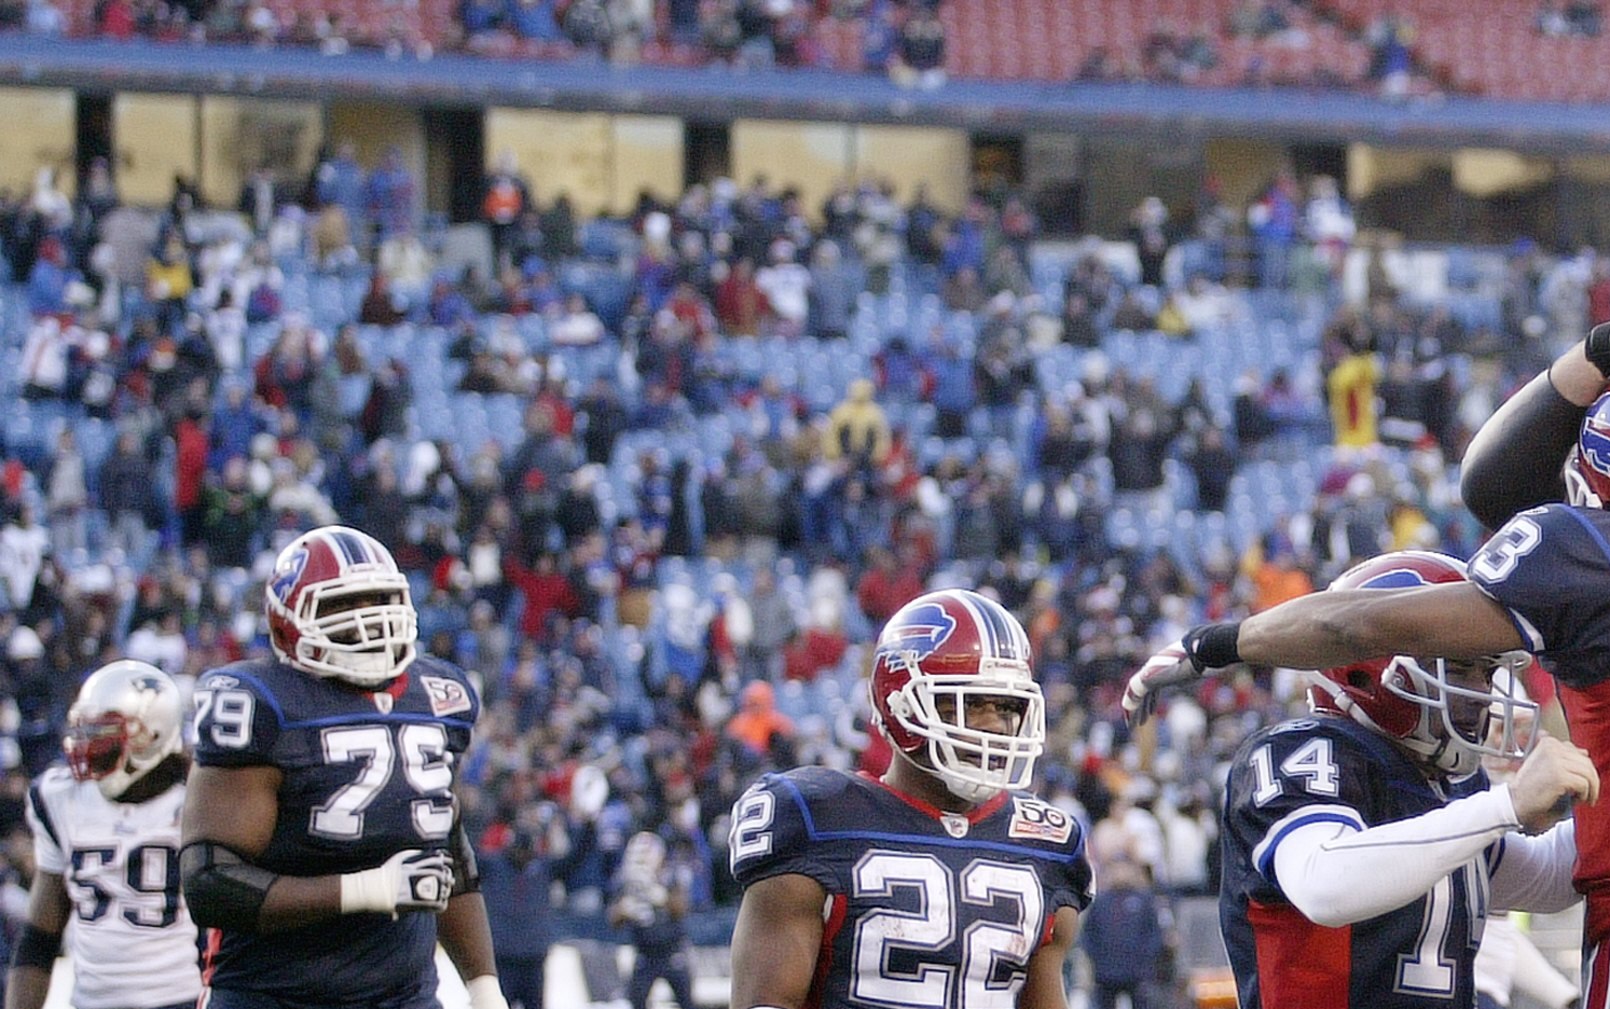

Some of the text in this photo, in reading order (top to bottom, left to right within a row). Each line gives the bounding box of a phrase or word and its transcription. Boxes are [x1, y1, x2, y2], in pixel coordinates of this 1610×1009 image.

[1467, 513, 1543, 584] 3
[193, 689, 256, 749] 79
[1250, 736, 1342, 807] 14
[729, 789, 776, 872] 2
[1020, 801, 1067, 829] 50
[70, 839, 182, 931] 59
